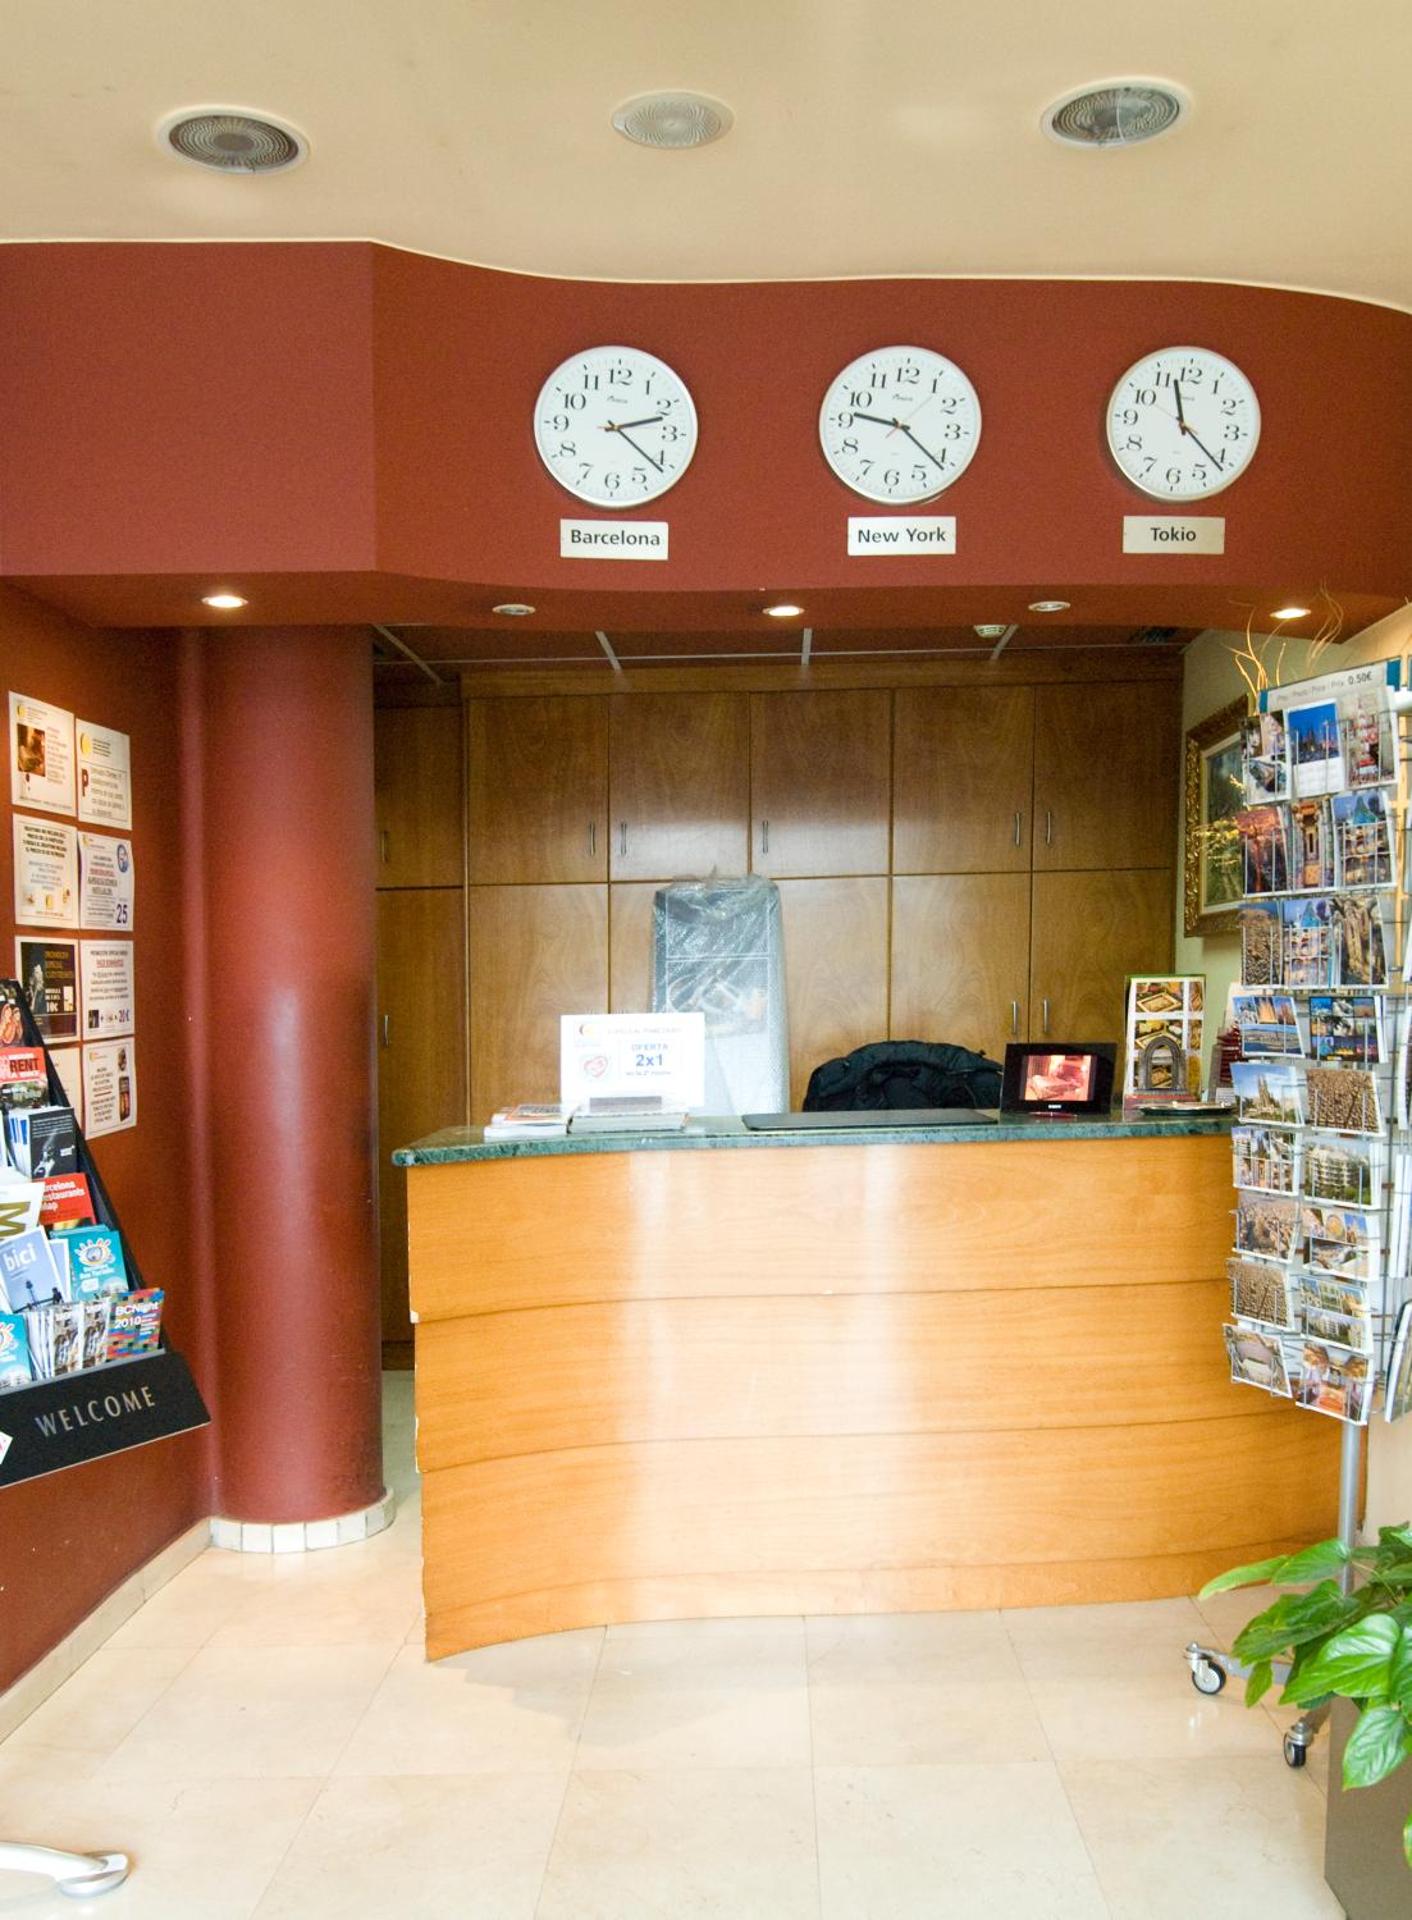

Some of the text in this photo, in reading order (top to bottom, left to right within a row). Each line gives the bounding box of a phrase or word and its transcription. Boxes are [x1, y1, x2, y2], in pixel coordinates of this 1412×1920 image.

[584, 374, 599, 390] 11
[608, 368, 633, 385] 12
[871, 373, 886, 389] 11
[897, 367, 920, 384] 12
[1155, 371, 1171, 387] 11
[1180, 367, 1202, 385] 12
[564, 393, 587, 409] 10
[850, 391, 872, 408] 10
[942, 397, 956, 414] 2
[1135, 389, 1157, 406] 10
[656, 399, 671, 416] 2
[1221, 399, 1236, 416] 2
[553, 414, 569, 432] 9
[838, 412, 854, 429] 9
[1123, 409, 1139, 425] 9
[661, 425, 678, 442] 3
[945, 424, 961, 440] 3
[1224, 424, 1239, 441] 3
[559, 440, 576, 459] 8
[841, 438, 859, 455] 8
[1126, 434, 1142, 451] 8
[652, 450, 665, 465] 4
[935, 448, 946, 463] 4
[1213, 448, 1225, 463] 4
[579, 463, 593, 481] 7
[860, 459, 874, 476] 7
[911, 464, 926, 481] 5
[1143, 457, 1157, 472] 7
[1192, 464, 1206, 481] 5
[605, 471, 620, 490] 6
[631, 467, 647, 484] 5
[884, 469, 900, 486] 6
[1166, 467, 1181, 484] 6
[571, 530, 660, 545] Barcelona
[858, 527, 946, 543] New York
[1151, 527, 1196, 542] Tokio
[1347, 671, 1373, 685] 0.50€
[116, 904, 128, 924] 25
[10, 1058, 39, 1073] RENT
[635, 1053, 663, 1067] 2x1
[3, 1242, 37, 1272] bici
[114, 1315, 142, 1329] 2010
[34, 1386, 156, 1438] WELCOME
